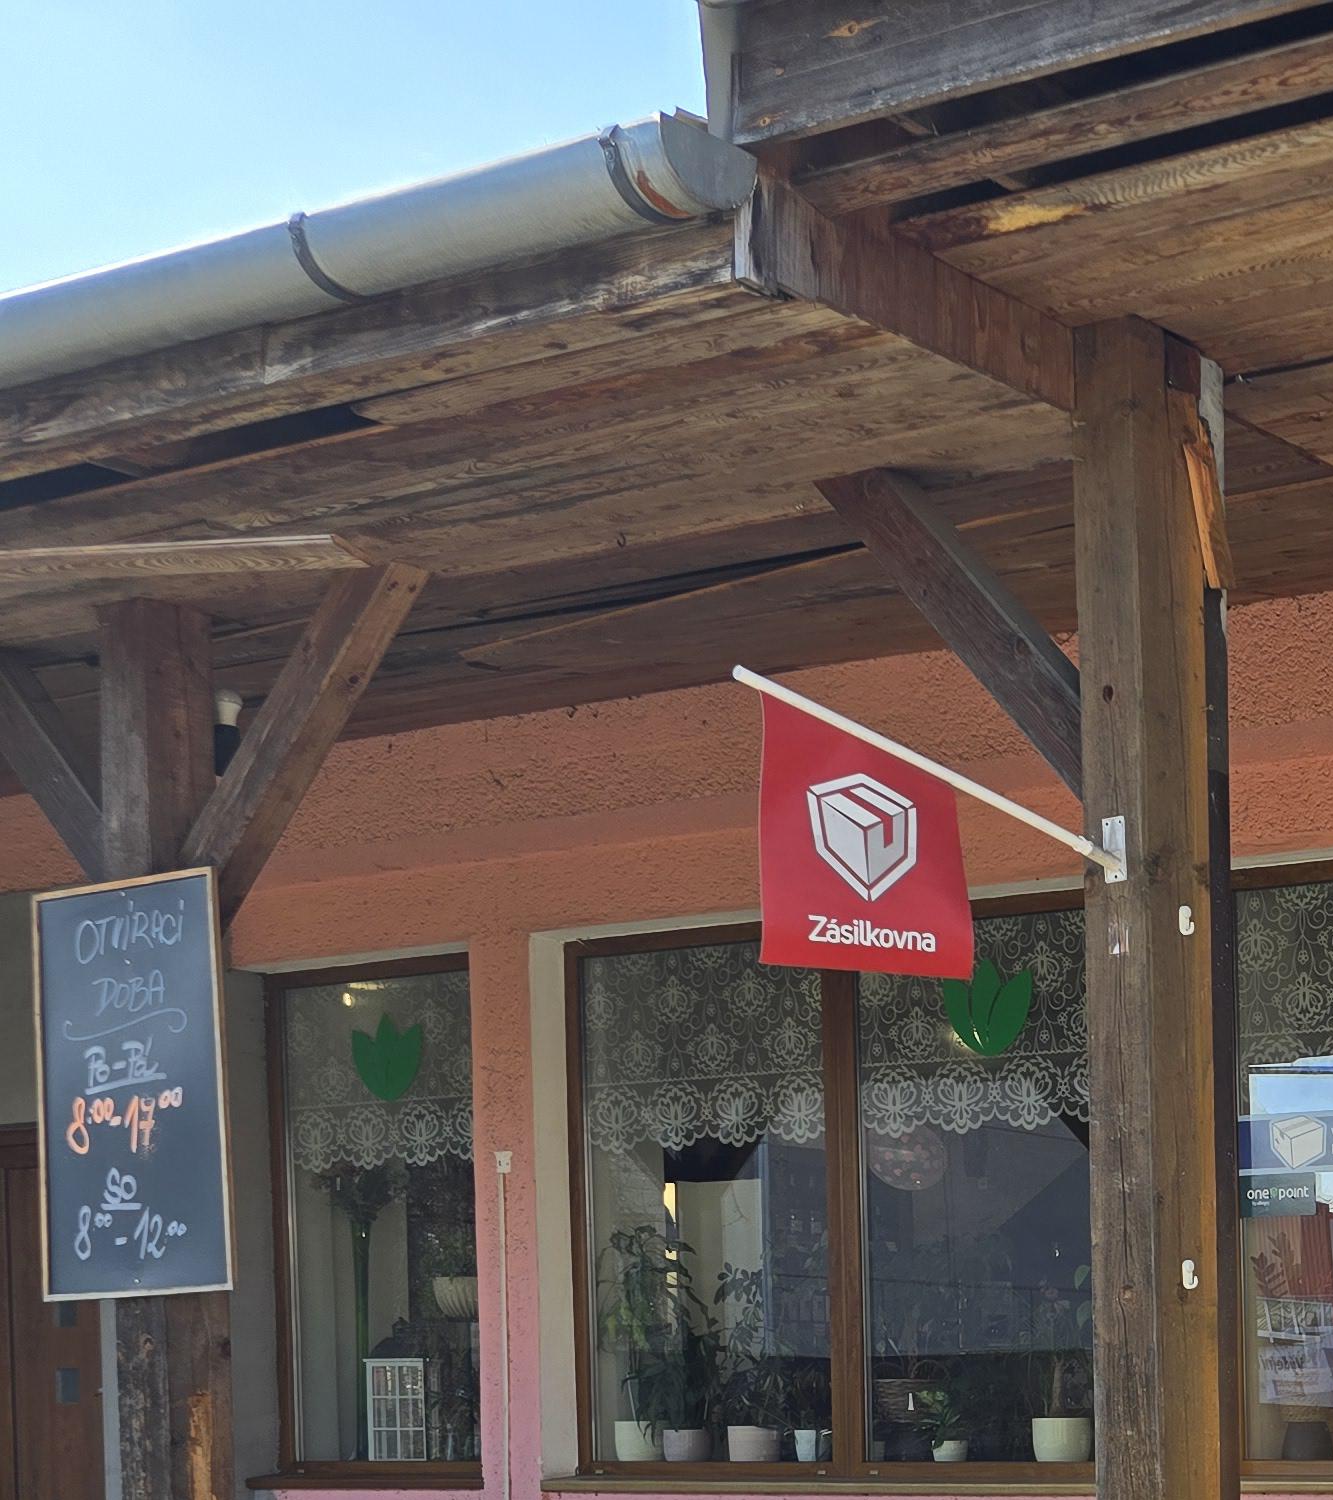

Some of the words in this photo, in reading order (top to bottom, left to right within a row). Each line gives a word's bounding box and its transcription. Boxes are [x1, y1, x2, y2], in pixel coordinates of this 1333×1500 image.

[808, 914, 936, 953] Zásilkovna
[91, 969, 165, 1016] DOBA
[1247, 1189, 1270, 1200] one
[1279, 1186, 1309, 1200] point
